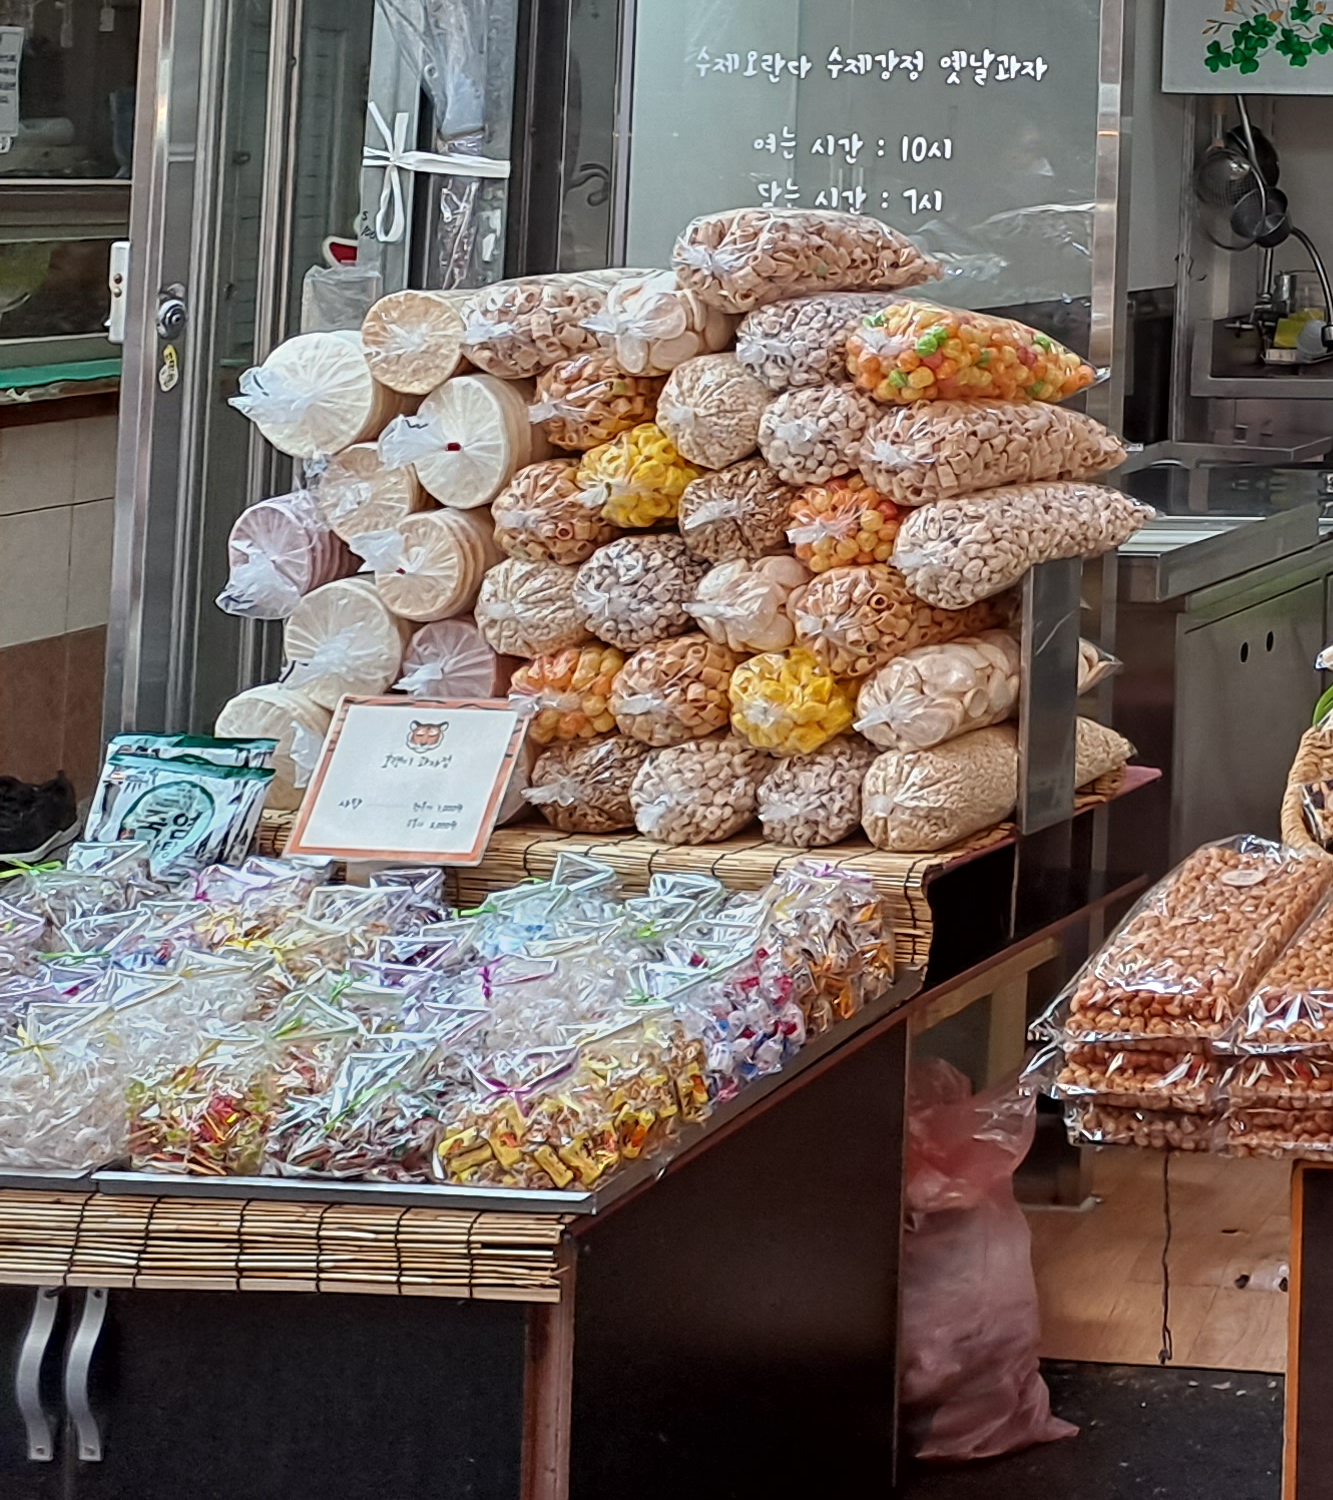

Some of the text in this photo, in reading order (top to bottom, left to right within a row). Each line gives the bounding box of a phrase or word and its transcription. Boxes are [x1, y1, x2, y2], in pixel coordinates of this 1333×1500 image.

[695, 46, 1048, 86] 수제오란다 수제강정 옛날과자
[753, 126, 798, 160] 여는
[810, 132, 863, 164] 시간
[901, 135, 953, 163] 10시
[758, 178, 800, 208] 닫는
[815, 186, 866, 215] 시간
[903, 188, 942, 215] 7시
